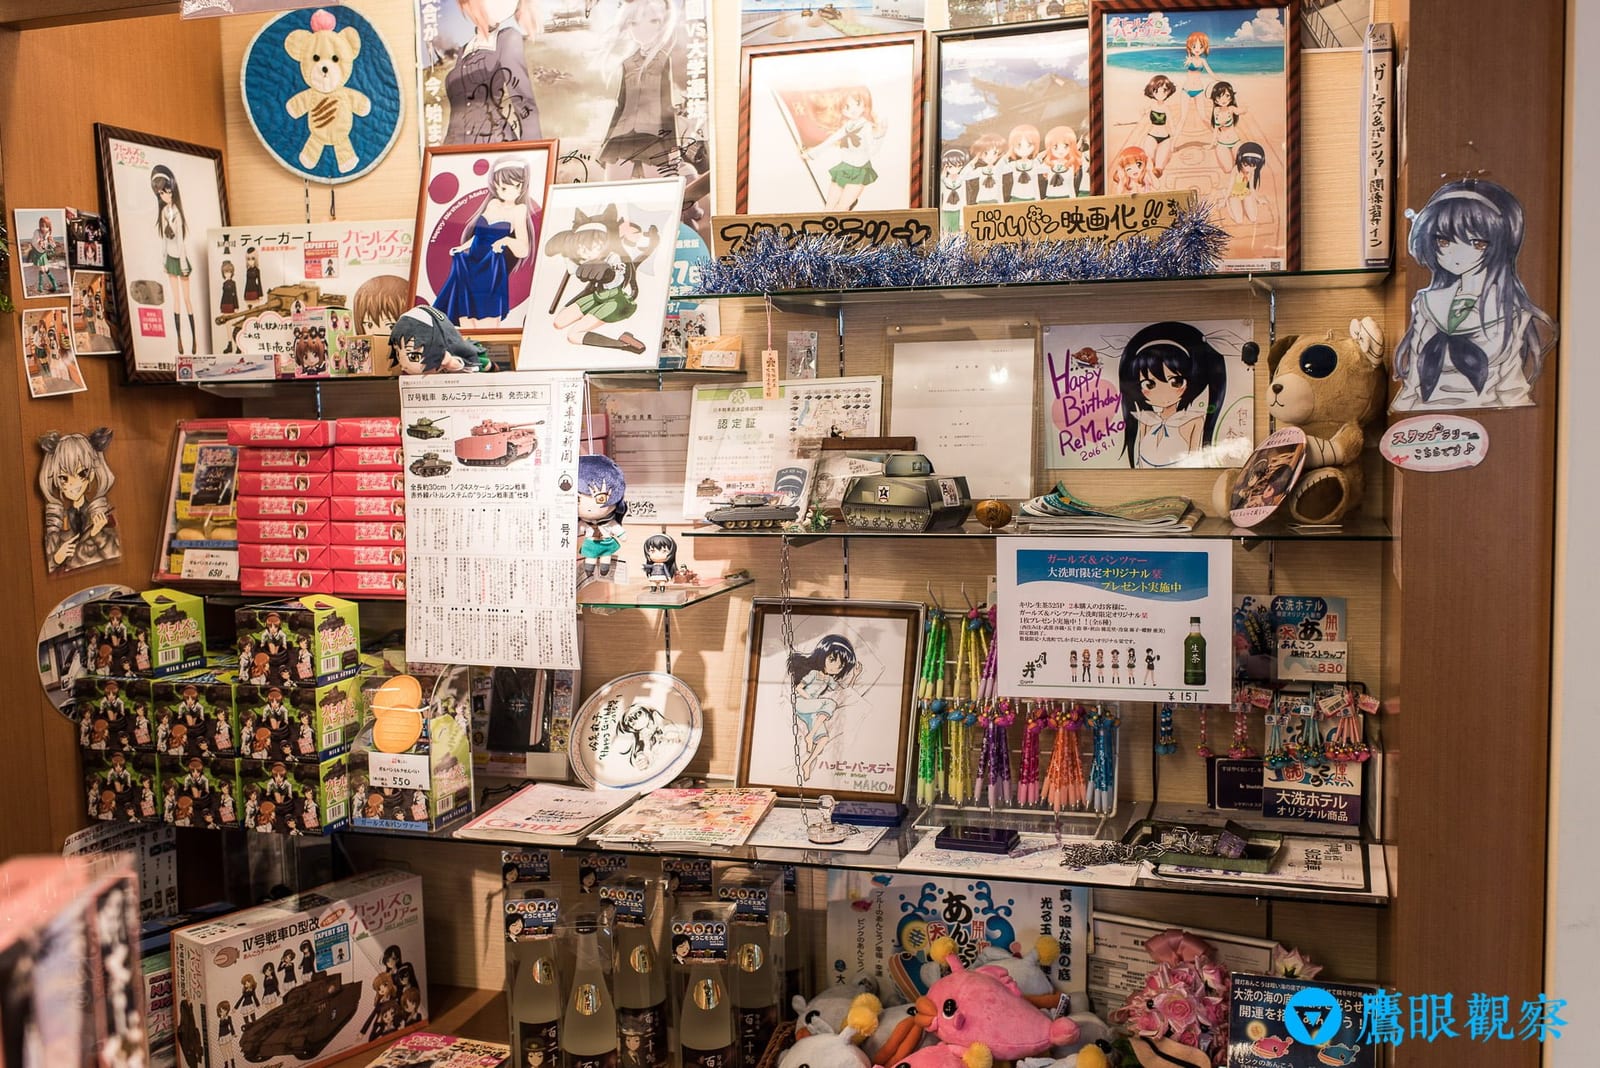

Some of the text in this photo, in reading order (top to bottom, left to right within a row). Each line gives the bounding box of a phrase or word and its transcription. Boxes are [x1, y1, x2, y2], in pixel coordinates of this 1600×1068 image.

[1048, 349, 1102, 400] Happy
[1062, 392, 1123, 427] Birthday
[717, 418, 756, 429] 認定証
[208, 569, 222, 577] 650
[1101, 582, 1182, 593] プレゼント実施中
[1191, 644, 1200, 664] 生茶
[818, 760, 894, 774] ハッピーバースデー
[392, 777, 410, 786] 550
[1276, 790, 1347, 809] 大洗ホテル
[1277, 806, 1348, 822] オリジナル商品
[315, 924, 347, 940] EXPERT SET
